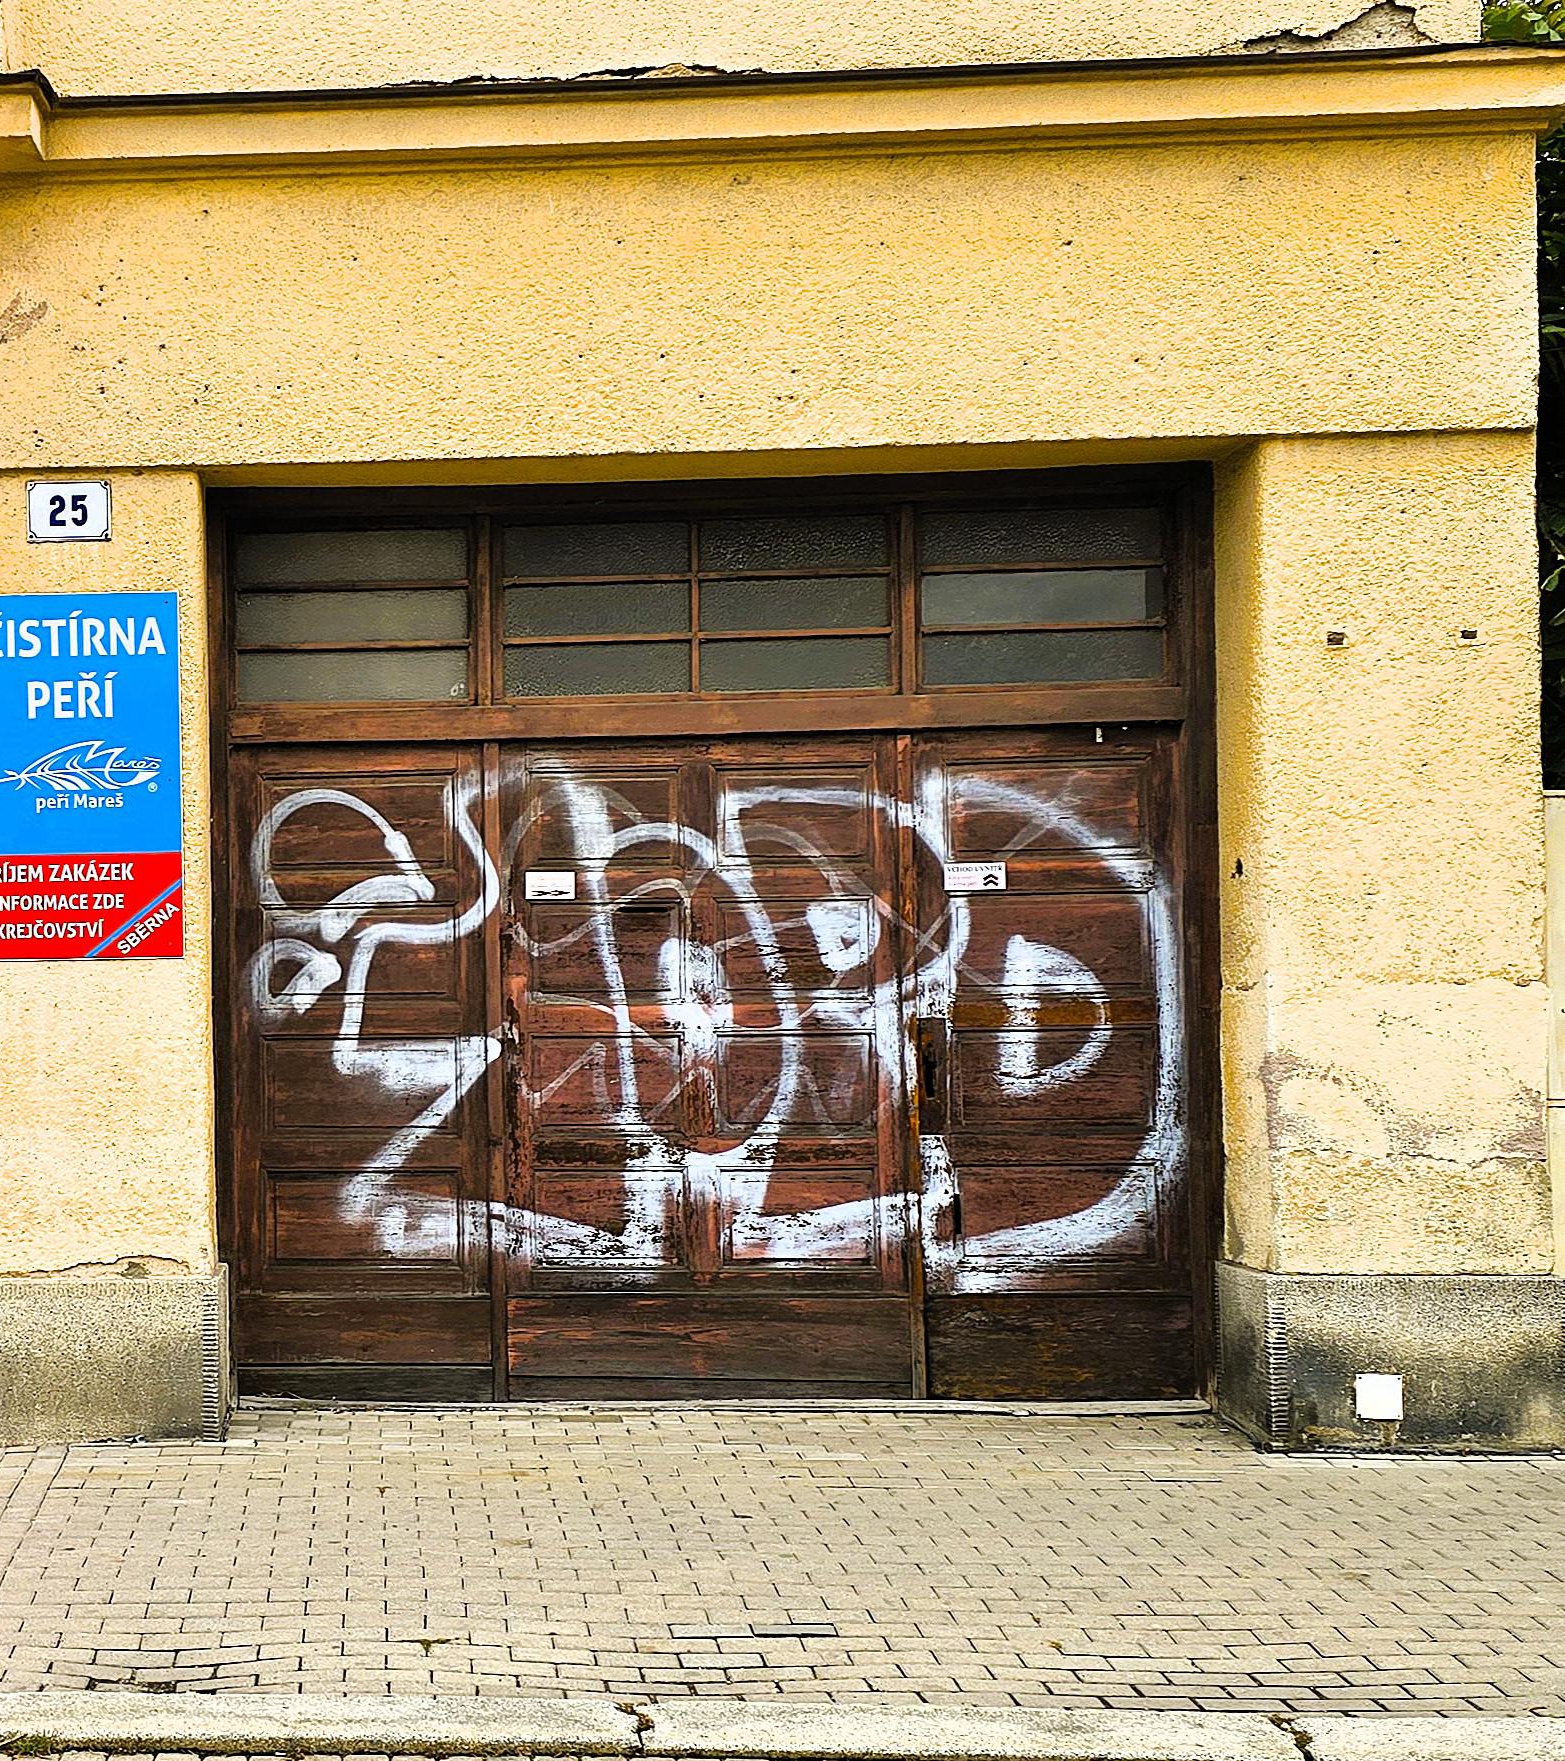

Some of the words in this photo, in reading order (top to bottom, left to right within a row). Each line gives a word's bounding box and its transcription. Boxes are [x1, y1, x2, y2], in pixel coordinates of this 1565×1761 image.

[49, 495, 88, 527] 25
[26, 671, 119, 720] PEŘÍ
[36, 793, 69, 813] peří
[73, 792, 124, 809] Mareš
[48, 860, 134, 882] ZAKÁZEK
[93, 893, 125, 909] ZDE
[117, 902, 180, 955] SBĚRNA
